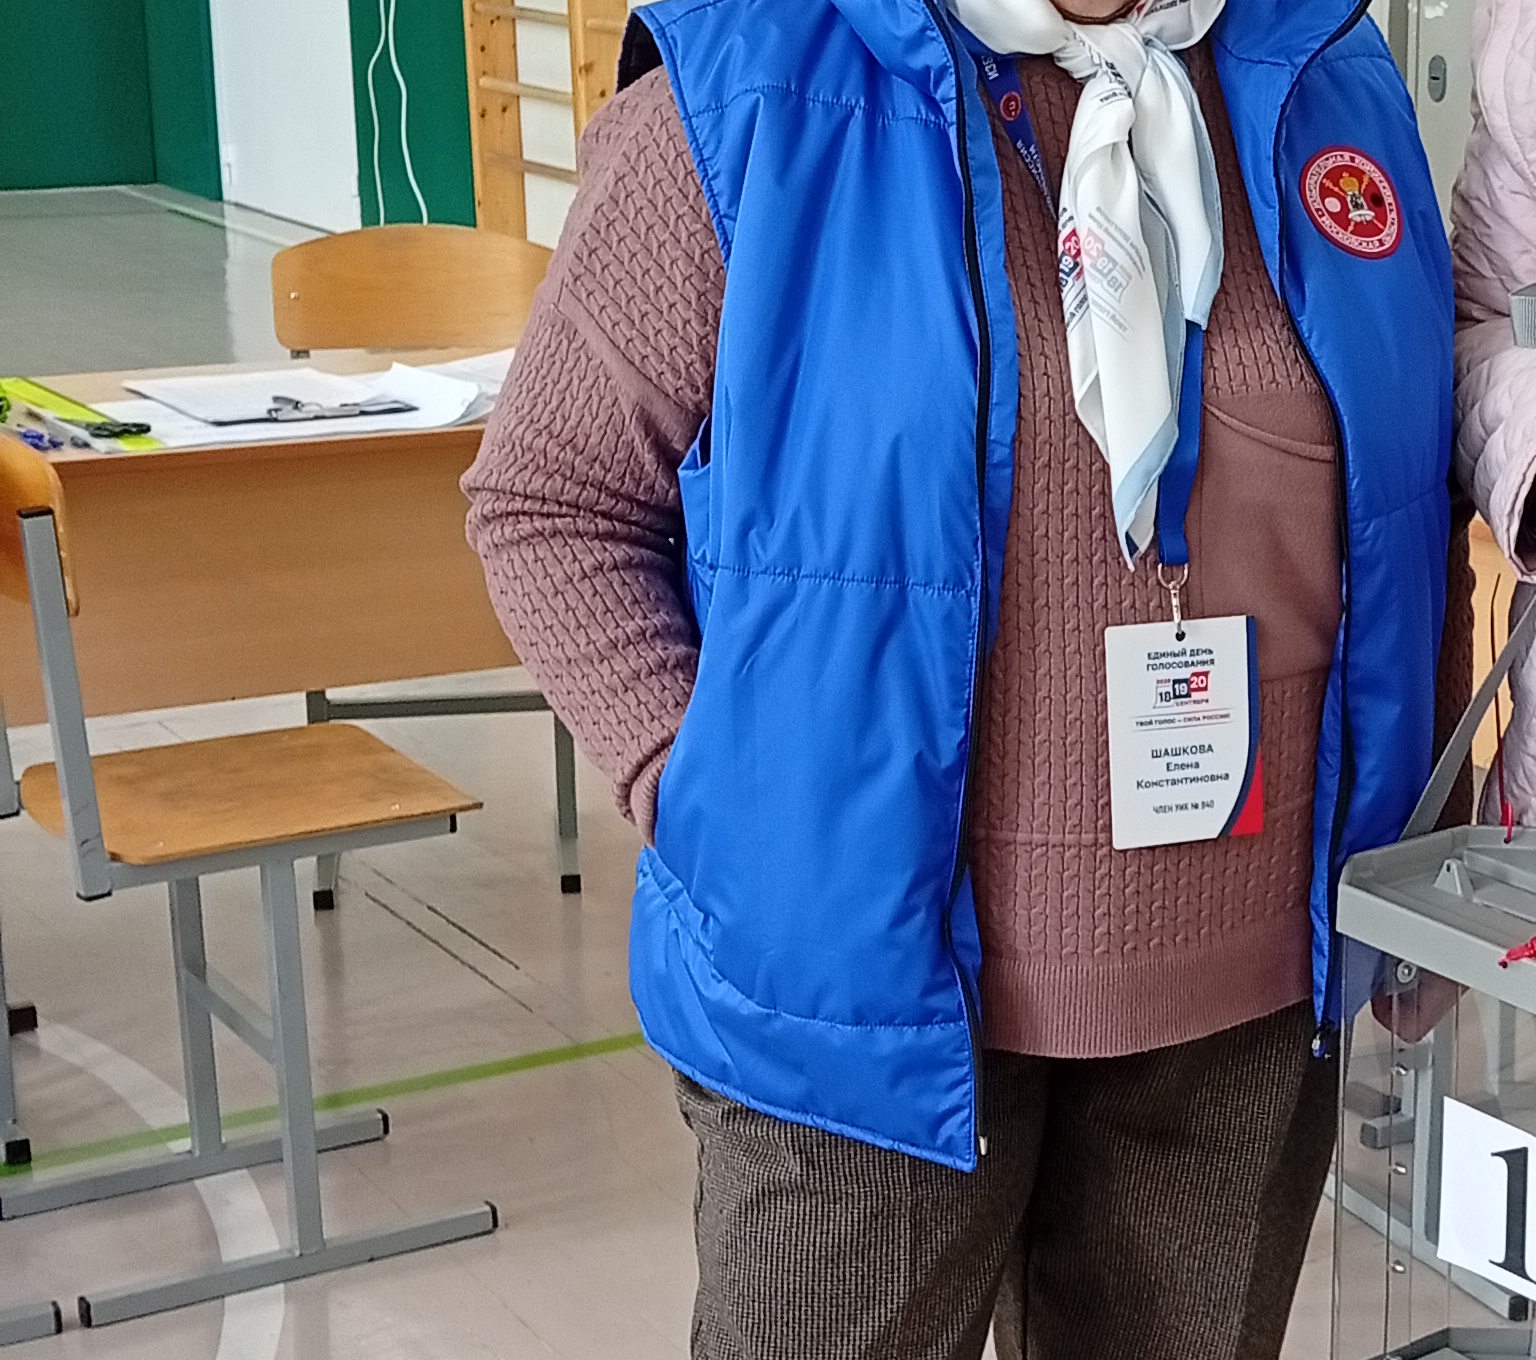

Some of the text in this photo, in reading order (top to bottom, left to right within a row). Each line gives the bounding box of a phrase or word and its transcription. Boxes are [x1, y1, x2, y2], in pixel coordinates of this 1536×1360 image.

[1147, 647, 1214, 660] ЕДИНЫЙ ДЕНЬ
[1146, 658, 1215, 671] ГОЛОСОВАНИЯ
[1159, 675, 1207, 703] 18 19 20
[1151, 743, 1214, 759] ШАШКОВА
[1166, 761, 1200, 772] Елена
[1136, 773, 1230, 790] Константиновна
[1153, 804, 1173, 814] ЧЛЕН
[1174, 802, 1189, 813] УИК
